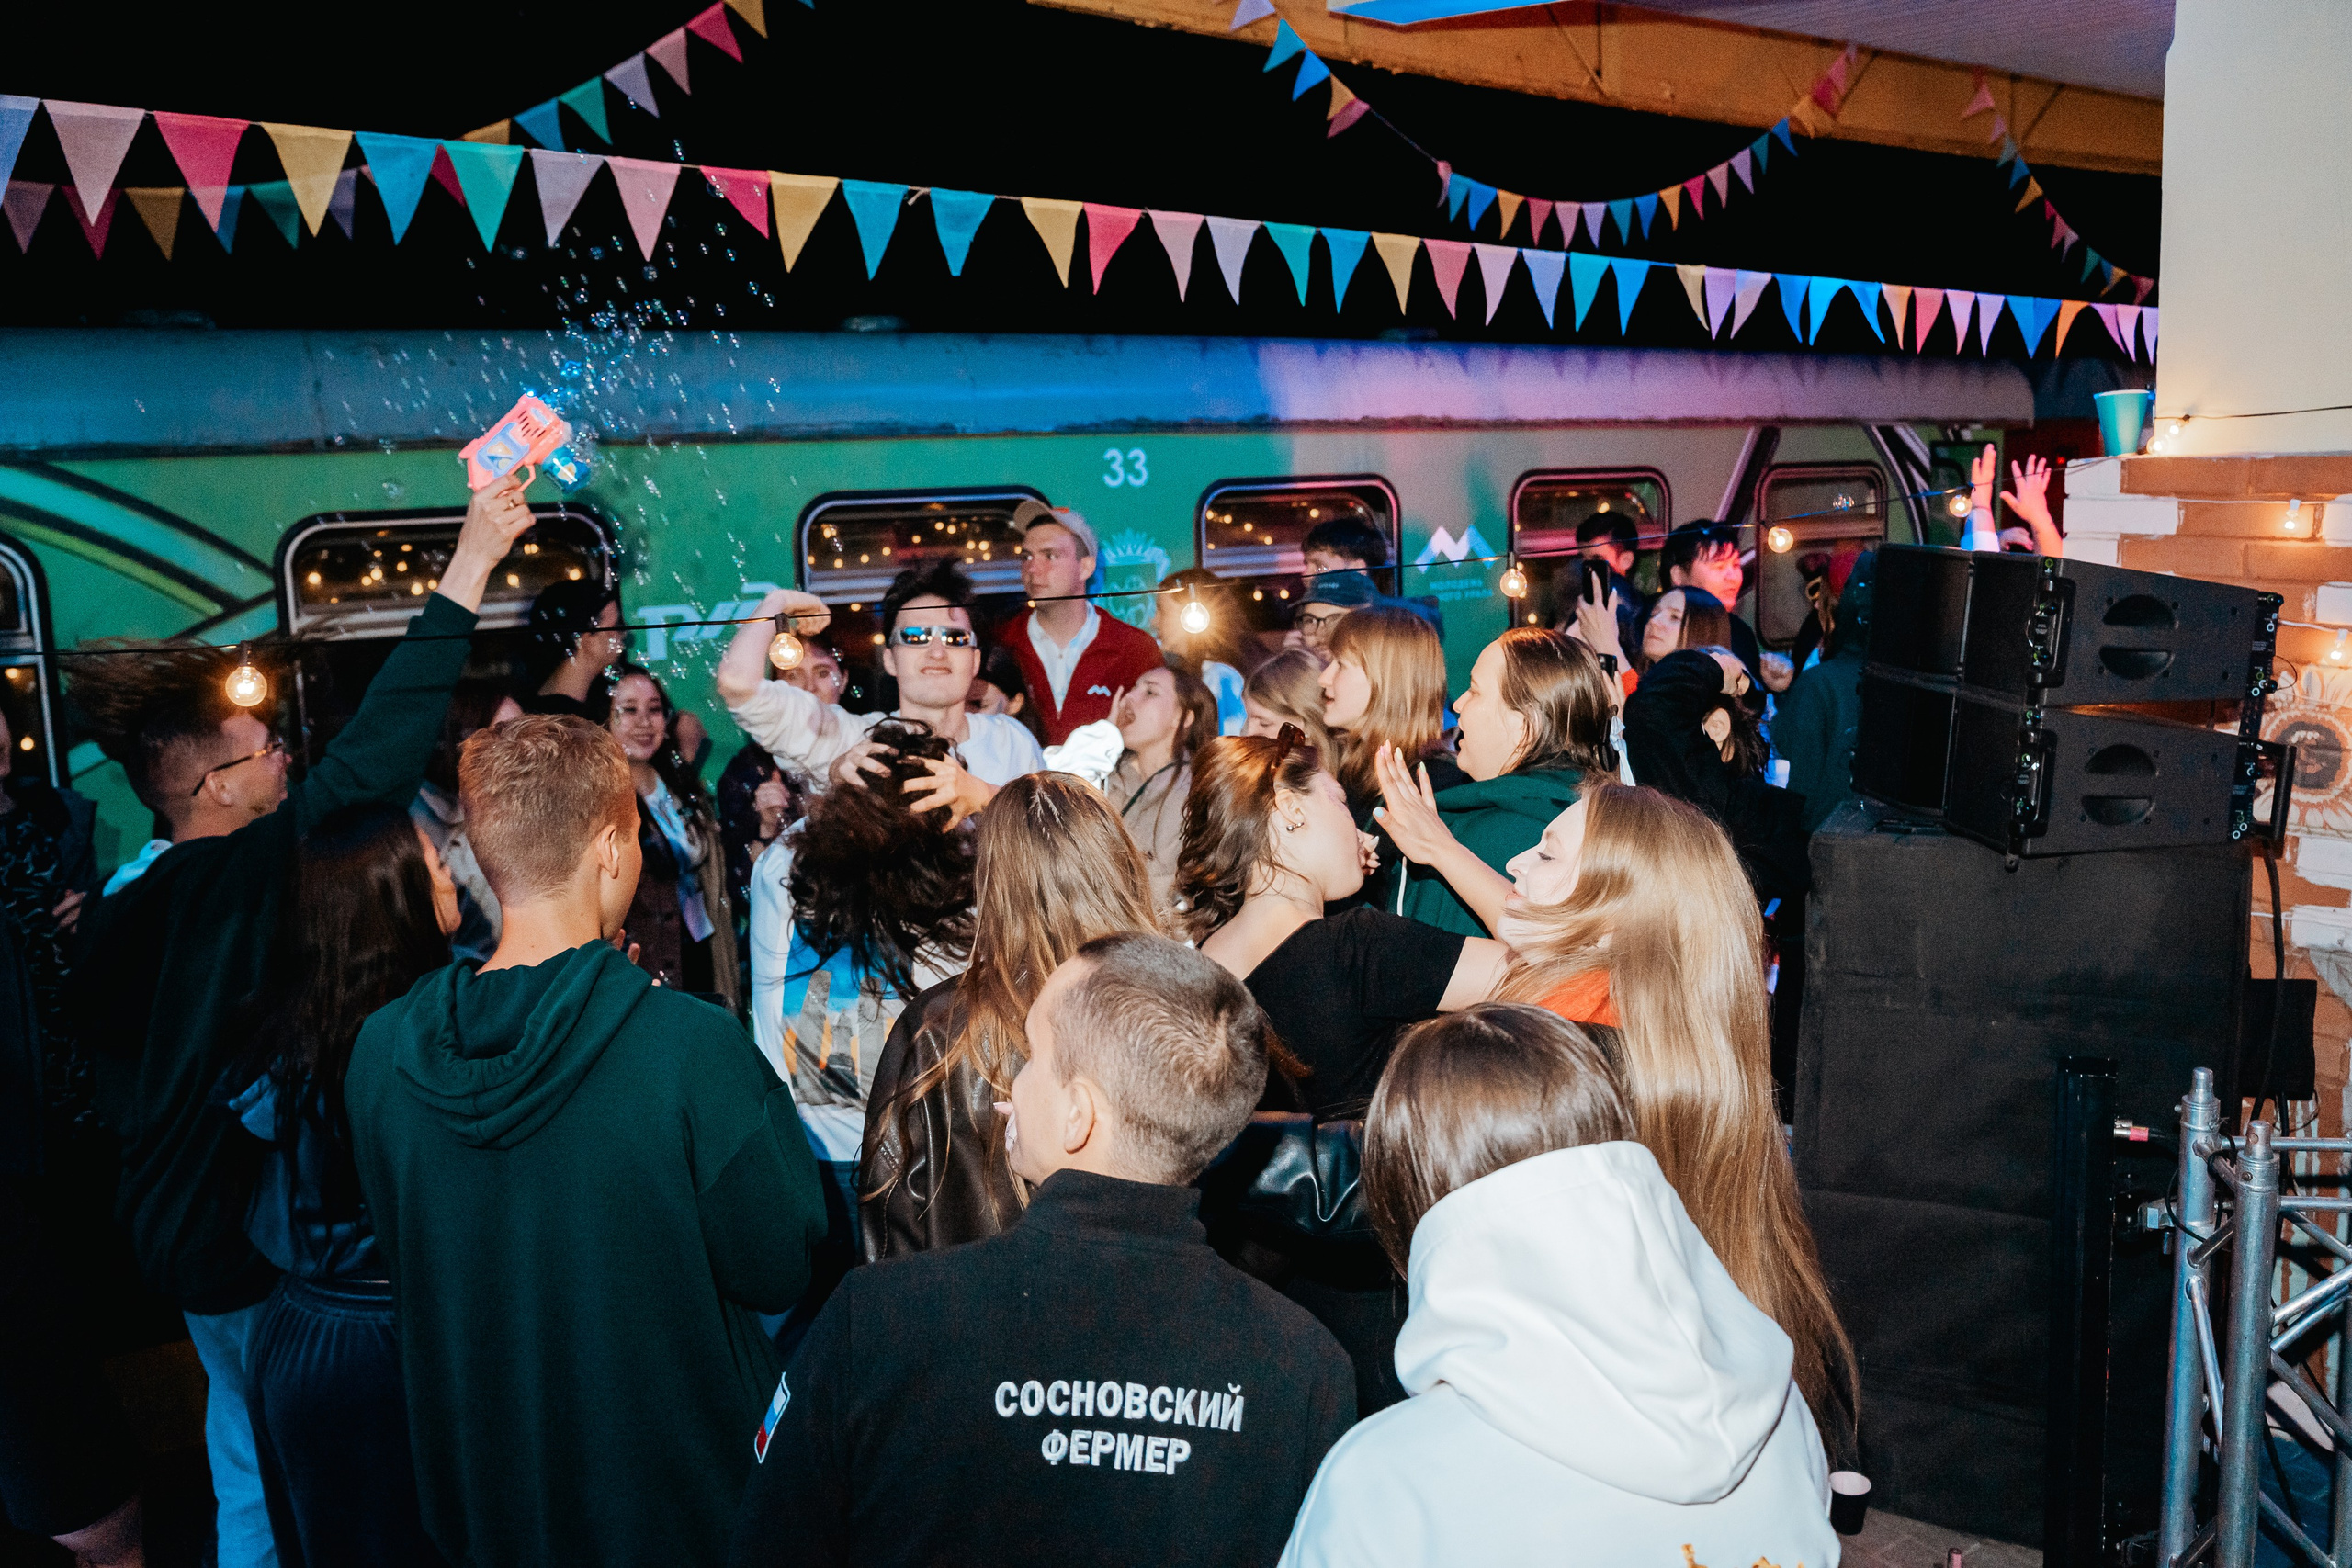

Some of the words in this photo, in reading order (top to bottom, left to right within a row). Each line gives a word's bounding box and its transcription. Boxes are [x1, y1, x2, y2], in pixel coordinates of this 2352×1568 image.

[1103, 447, 1148, 488] 33
[995, 1380, 1244, 1432] СОСНОВСКИЙ
[1041, 1429, 1192, 1475] ФЕРМЕР
